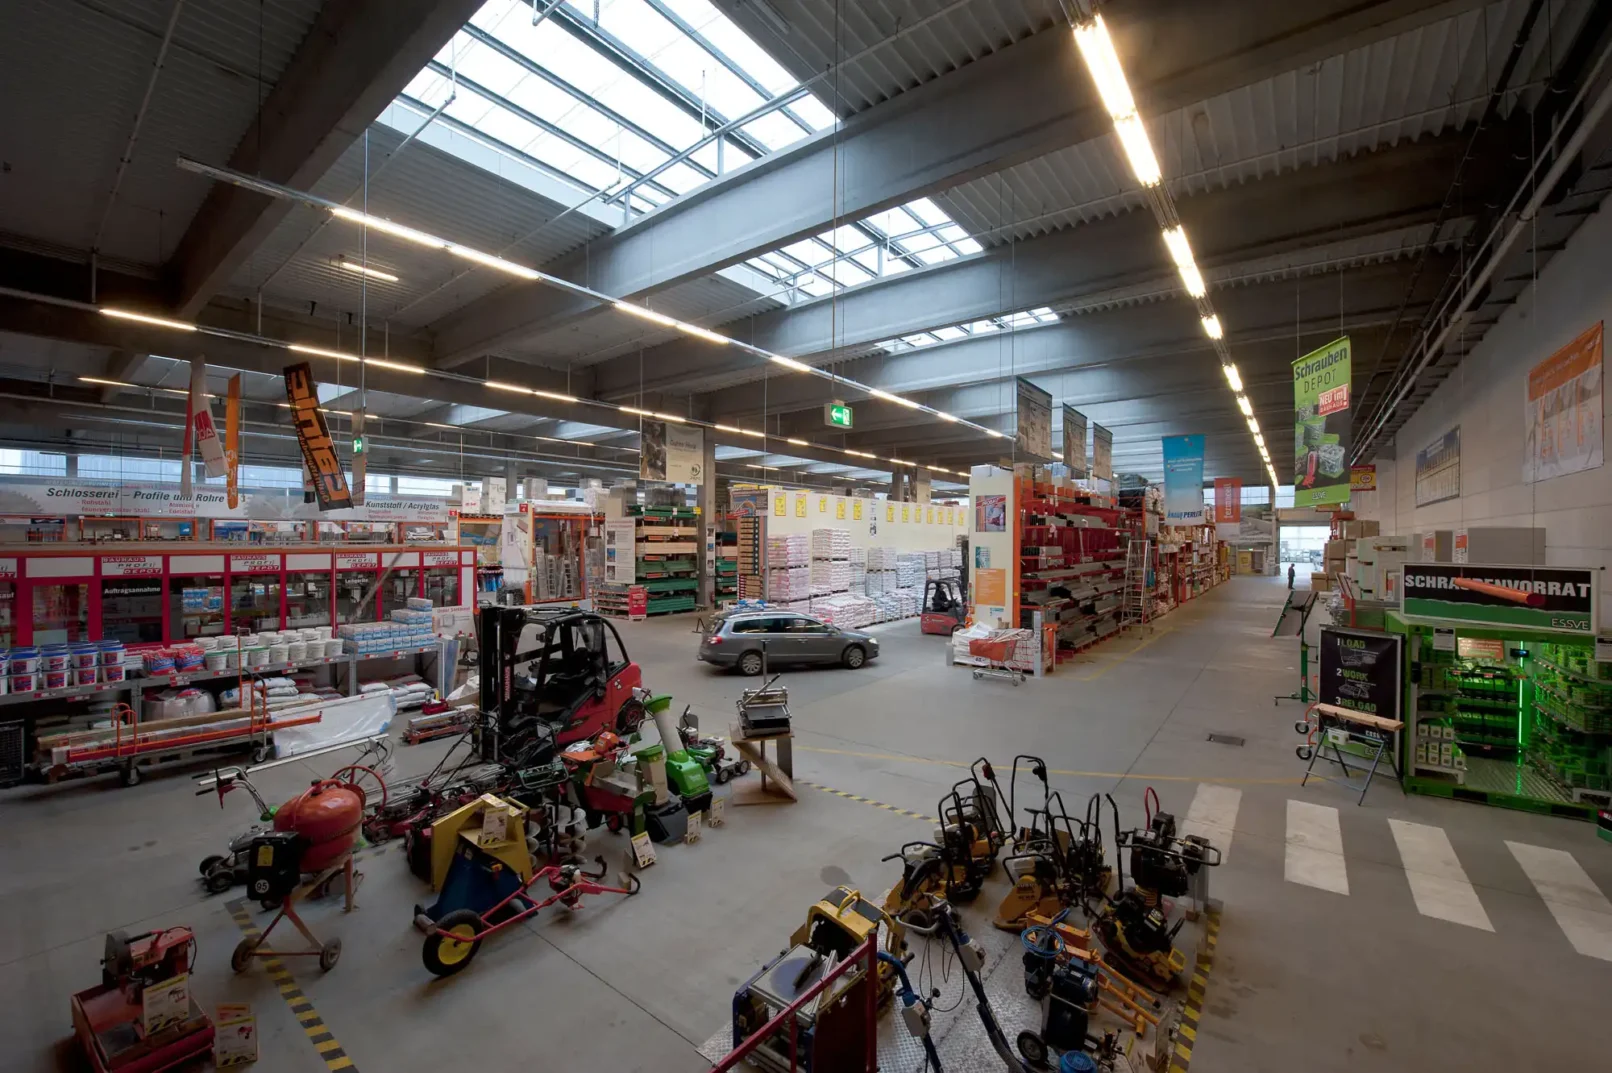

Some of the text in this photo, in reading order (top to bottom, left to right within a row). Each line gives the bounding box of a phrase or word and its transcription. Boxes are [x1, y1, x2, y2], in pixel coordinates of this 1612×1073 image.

[1295, 347, 1347, 381] Schrauben
[1304, 368, 1336, 394] DEPOT
[1319, 393, 1333, 406] NEU
[1333, 389, 1343, 402] im
[46, 487, 120, 499] Schlosserei
[133, 490, 170, 500] Profile
[196, 493, 225, 503] Rohre
[366, 501, 402, 509] Kunststoff
[408, 502, 440, 510] Acrylglas
[104, 586, 161, 595] Auftragsannahme
[1551, 618, 1590, 631] ESSVE
[1336, 638, 1366, 649] 1 LOAD
[1336, 668, 1369, 681] 2 WORK
[1335, 697, 1377, 712] 3 RELOAD
[256, 882, 268, 891] 95
